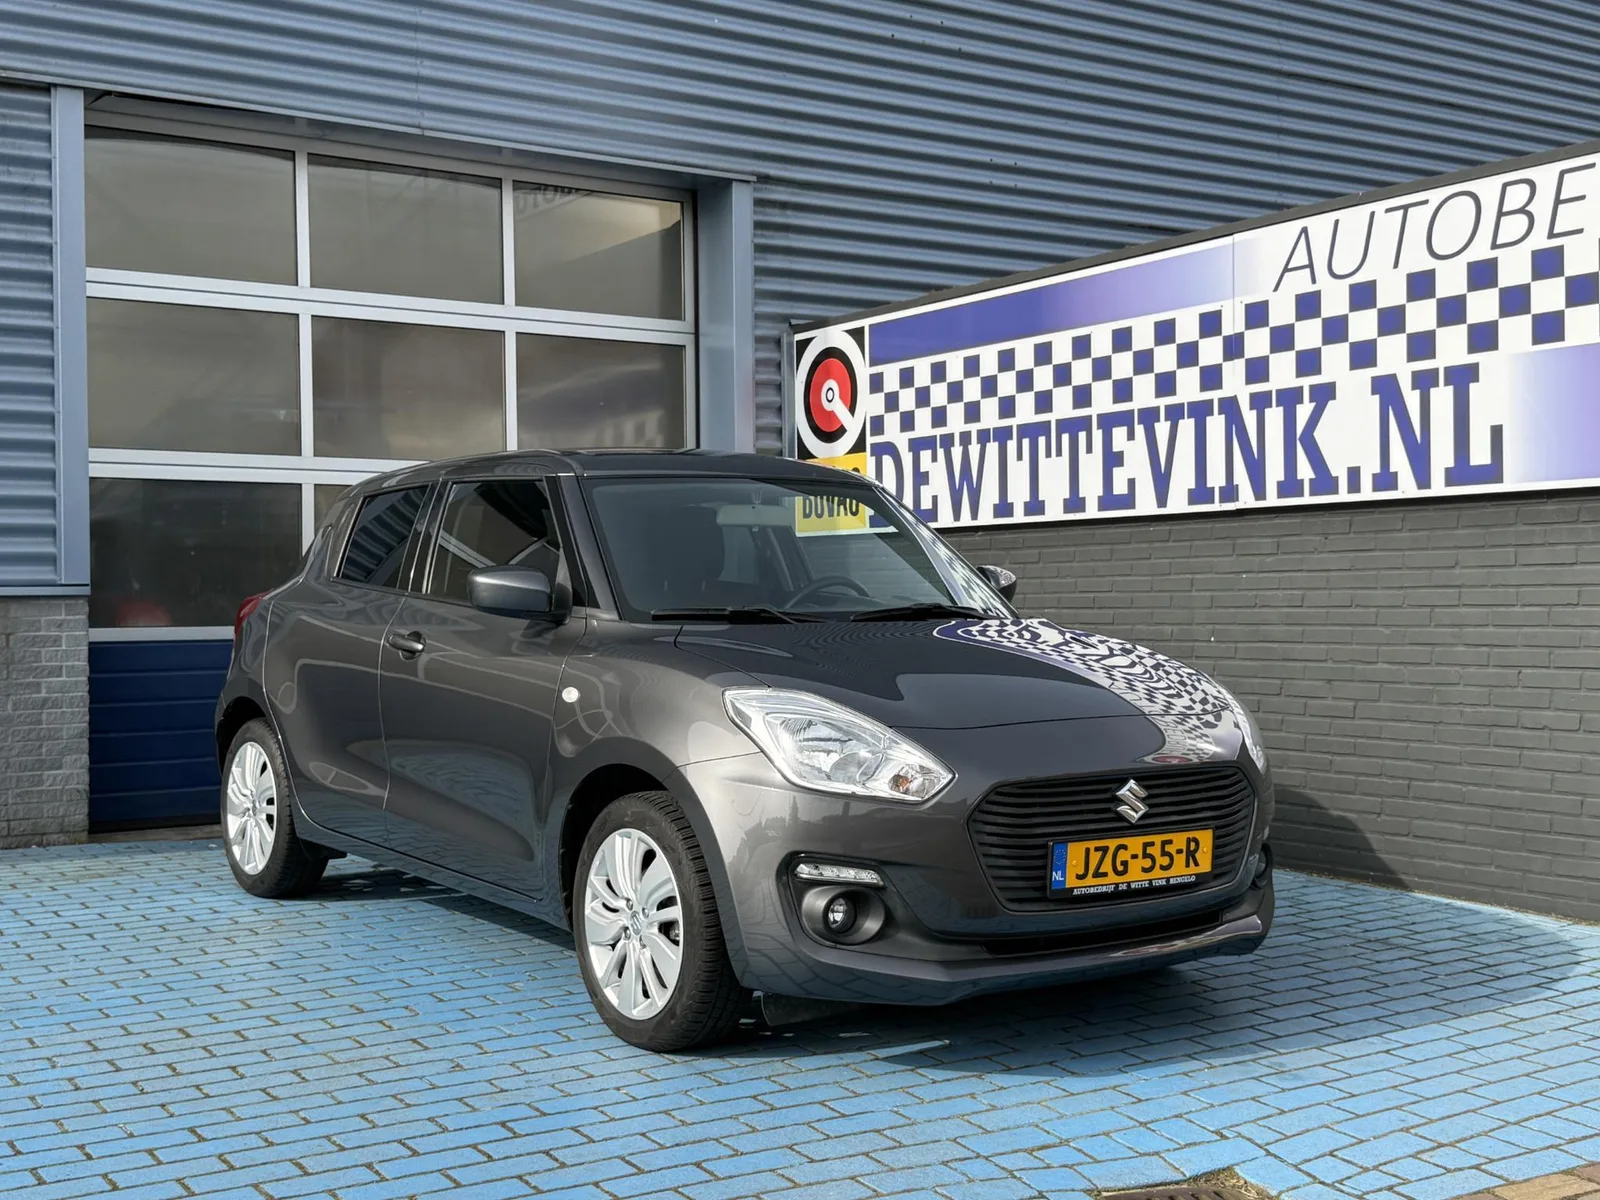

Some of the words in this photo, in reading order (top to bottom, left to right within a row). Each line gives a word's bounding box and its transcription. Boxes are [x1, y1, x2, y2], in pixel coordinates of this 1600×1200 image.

[1272, 162, 1597, 292] AUTOBE
[868, 363, 1503, 528] DEWITTEVINK.NL
[1052, 871, 1064, 881] NL
[1075, 836, 1200, 881] JZG-55-R
[1118, 883, 1128, 891] DE
